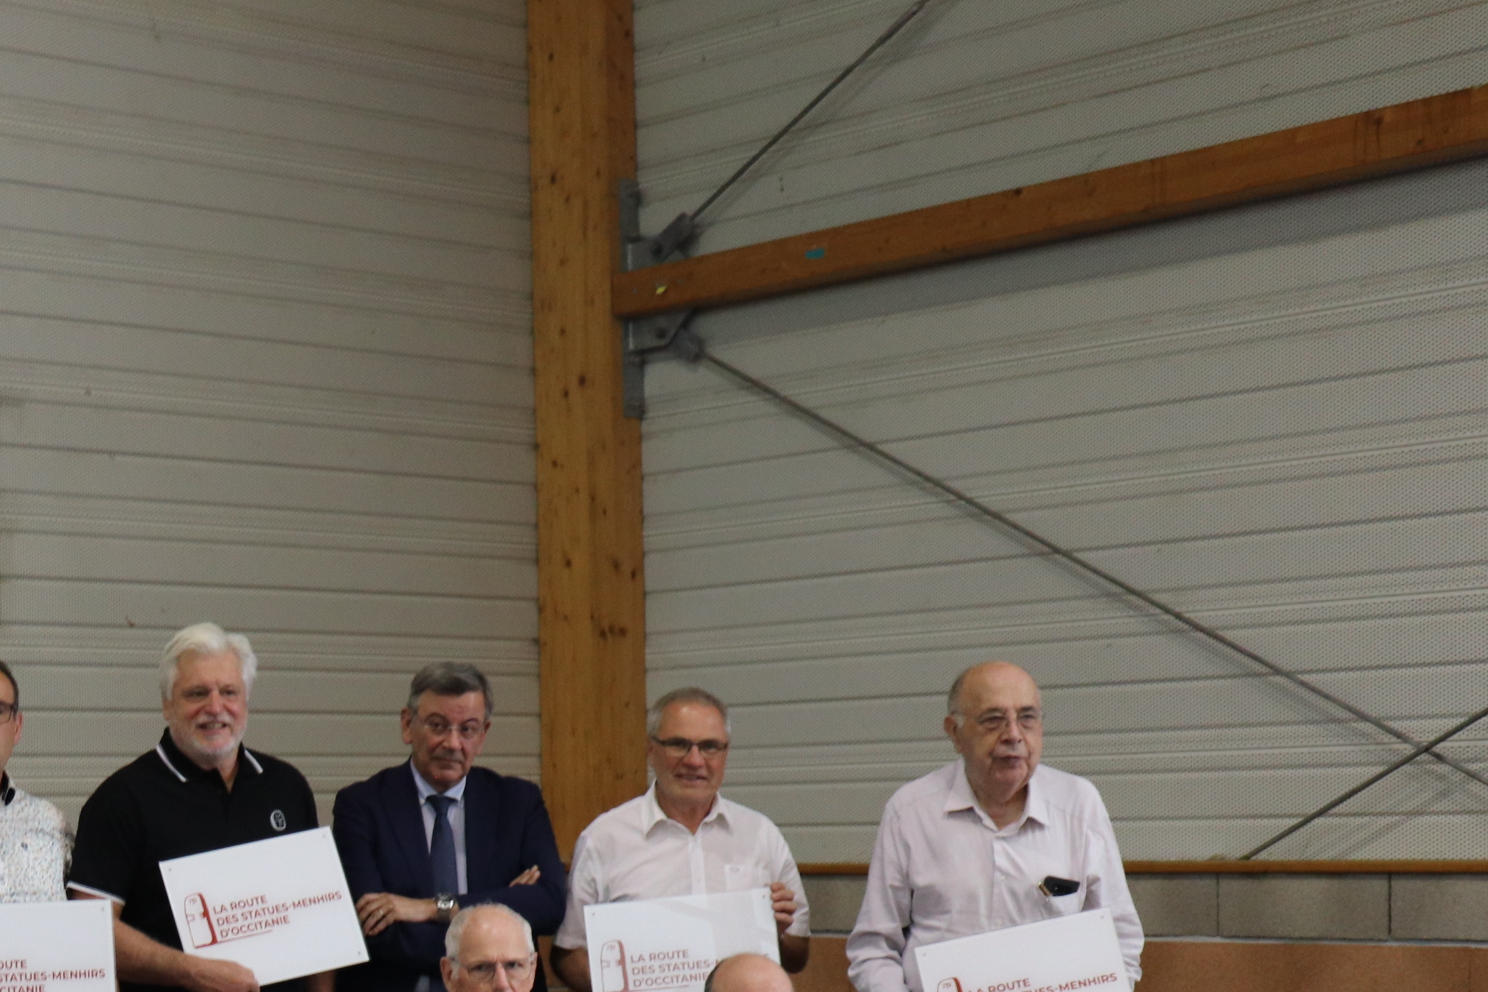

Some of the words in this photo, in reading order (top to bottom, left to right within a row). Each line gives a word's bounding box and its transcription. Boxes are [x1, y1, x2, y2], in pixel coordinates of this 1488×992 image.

[212, 903, 229, 915] LA
[230, 894, 268, 911] ROUTE
[216, 913, 239, 926] DES
[238, 891, 342, 920] STATUES-MENHIRS
[219, 915, 290, 938] D'OCCITANIE
[630, 953, 646, 963] LA
[648, 949, 689, 960] ROUTE
[632, 964, 655, 975] DES
[633, 971, 709, 987] D'OCCITANIE
